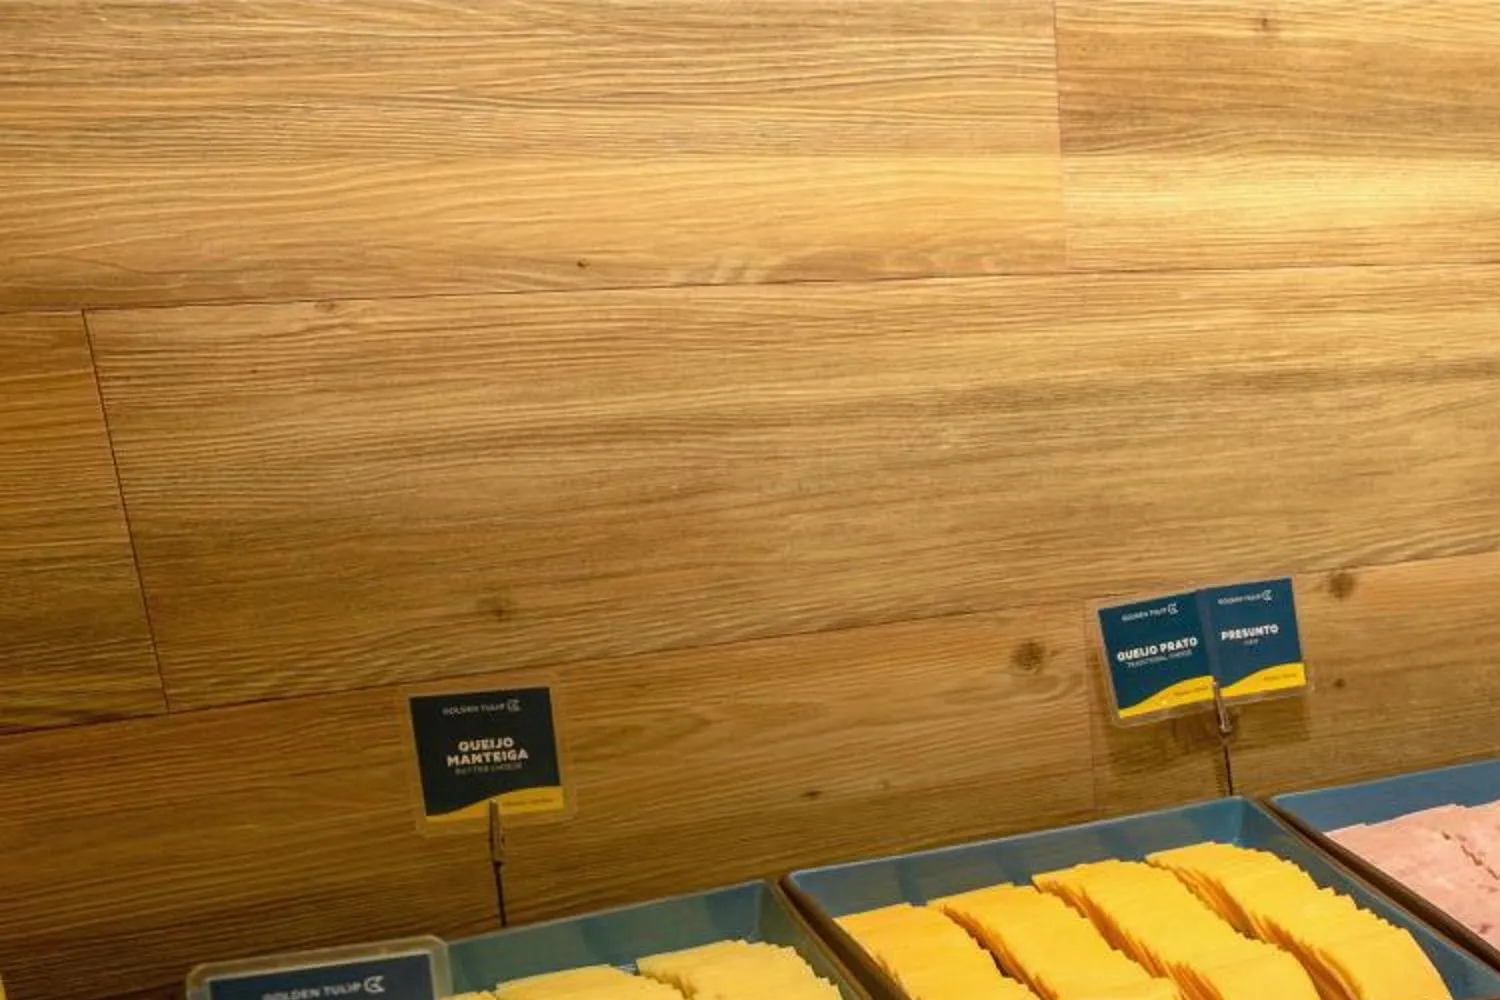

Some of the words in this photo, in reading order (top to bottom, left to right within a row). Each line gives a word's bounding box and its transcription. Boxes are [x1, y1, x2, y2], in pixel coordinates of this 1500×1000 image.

[1221, 624, 1279, 641] PRESUNTO
[1117, 645, 1159, 662] QUEIJO
[1160, 637, 1199, 653] PRATO
[458, 737, 514, 753] QUEIJO
[446, 748, 529, 767] MANTEIGA
[324, 982, 361, 996] TULIP
